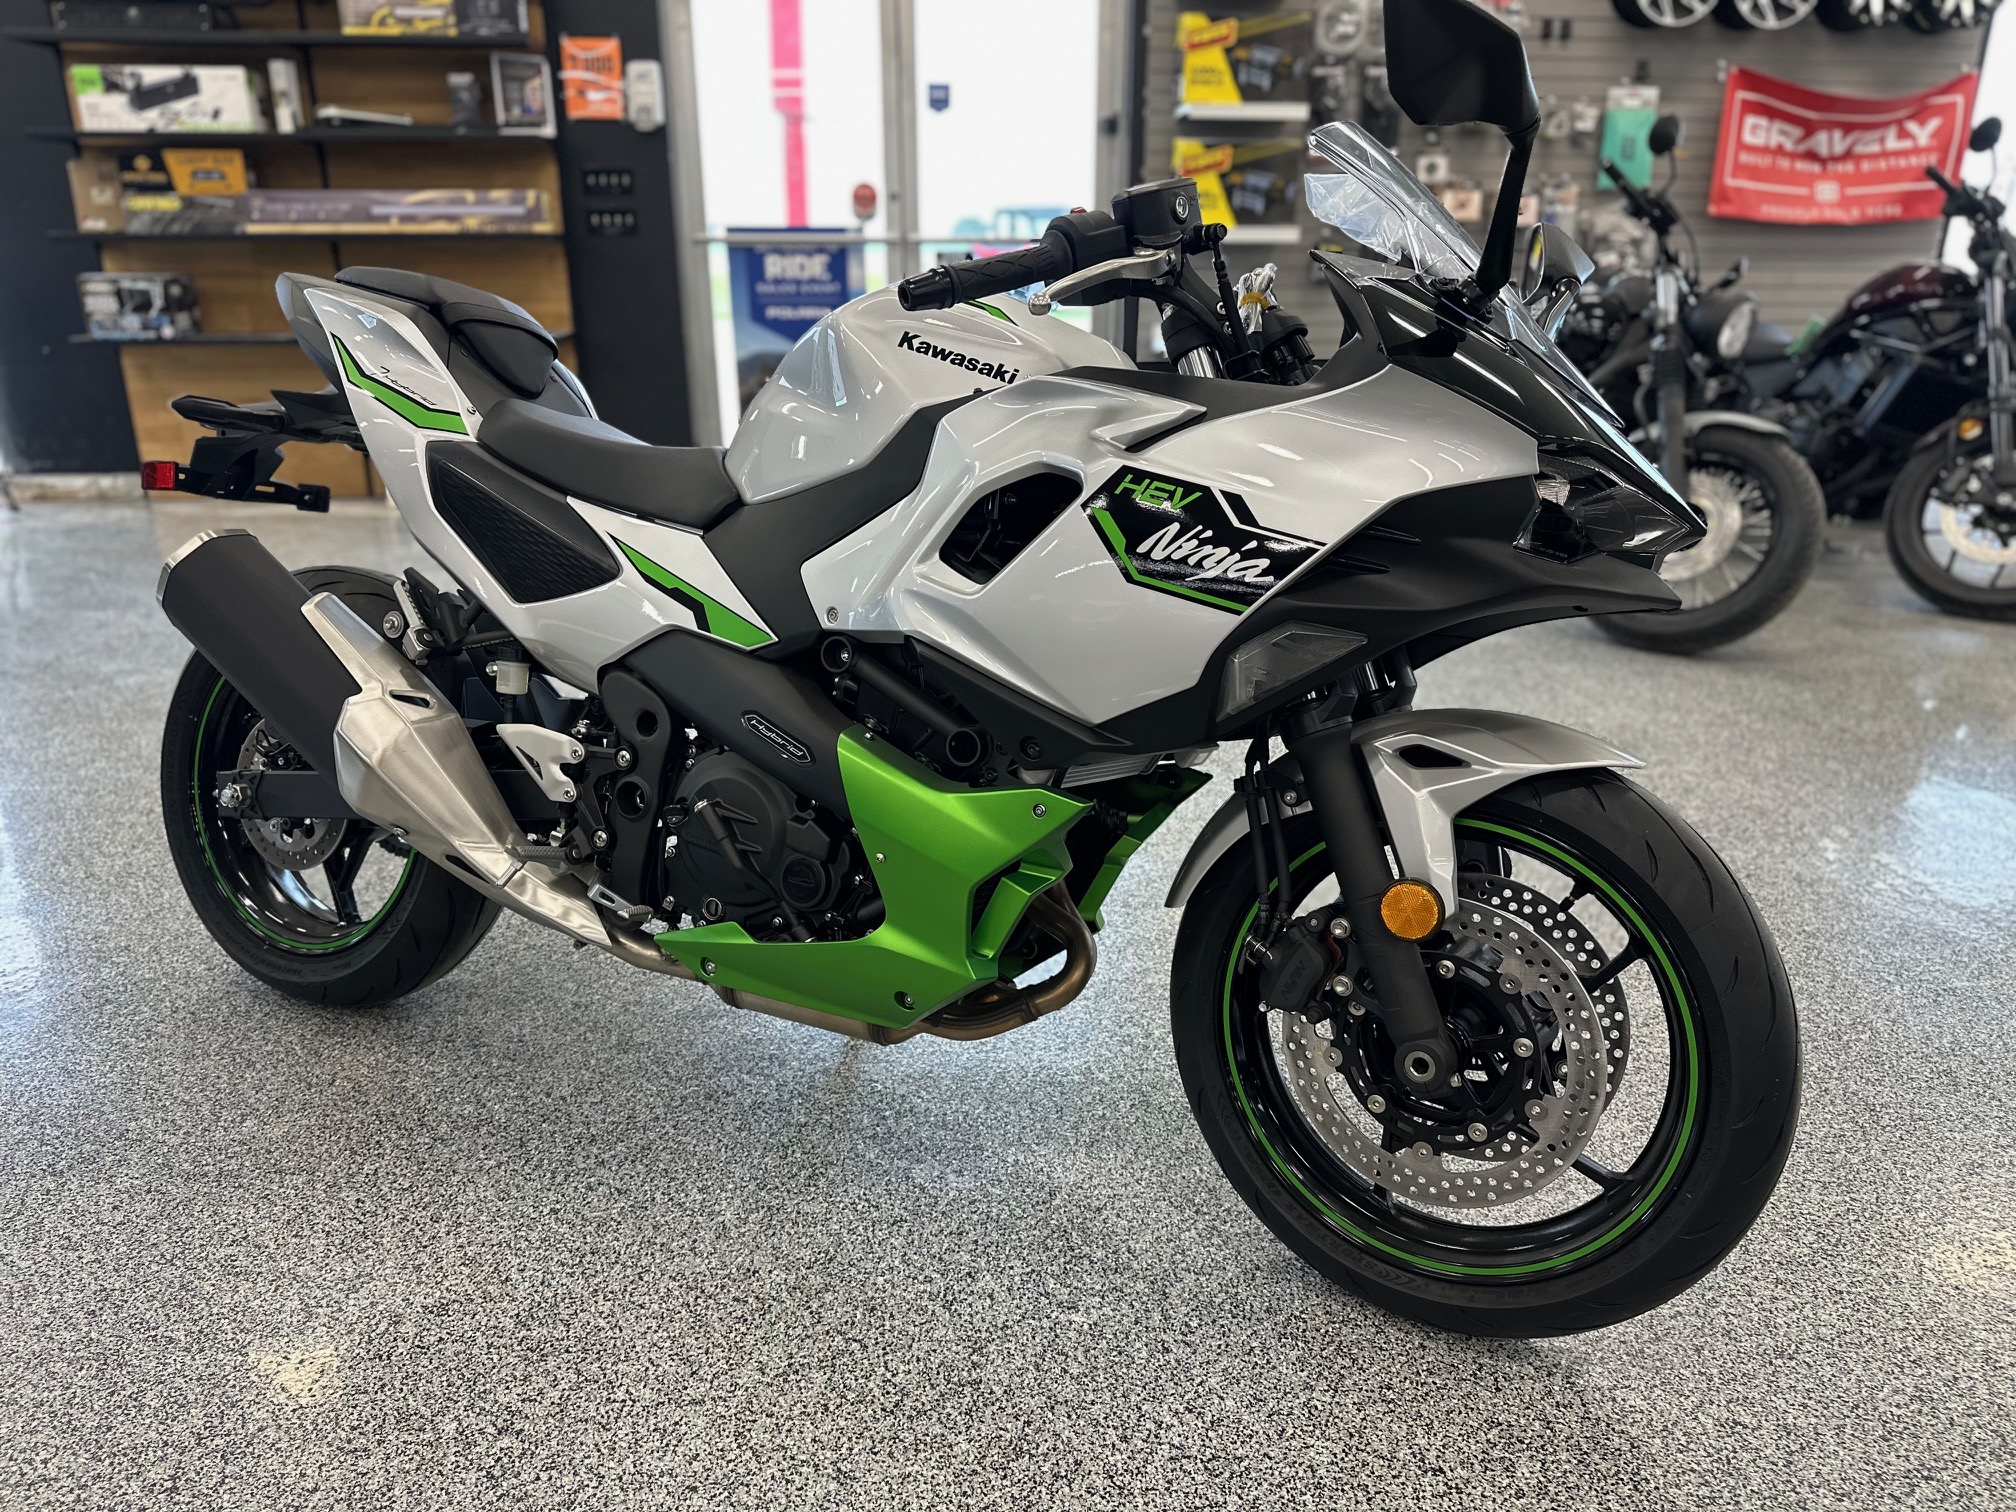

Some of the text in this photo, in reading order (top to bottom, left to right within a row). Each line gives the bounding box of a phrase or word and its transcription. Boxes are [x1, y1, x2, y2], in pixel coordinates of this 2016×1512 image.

[1743, 114, 1943, 157] GRAVELY
[763, 253, 832, 281] RIDE
[897, 330, 1020, 385] Kawasaki
[1114, 473, 1203, 510] HEV
[1136, 521, 1275, 583] Ninja
[750, 719, 804, 757] Hybrid
